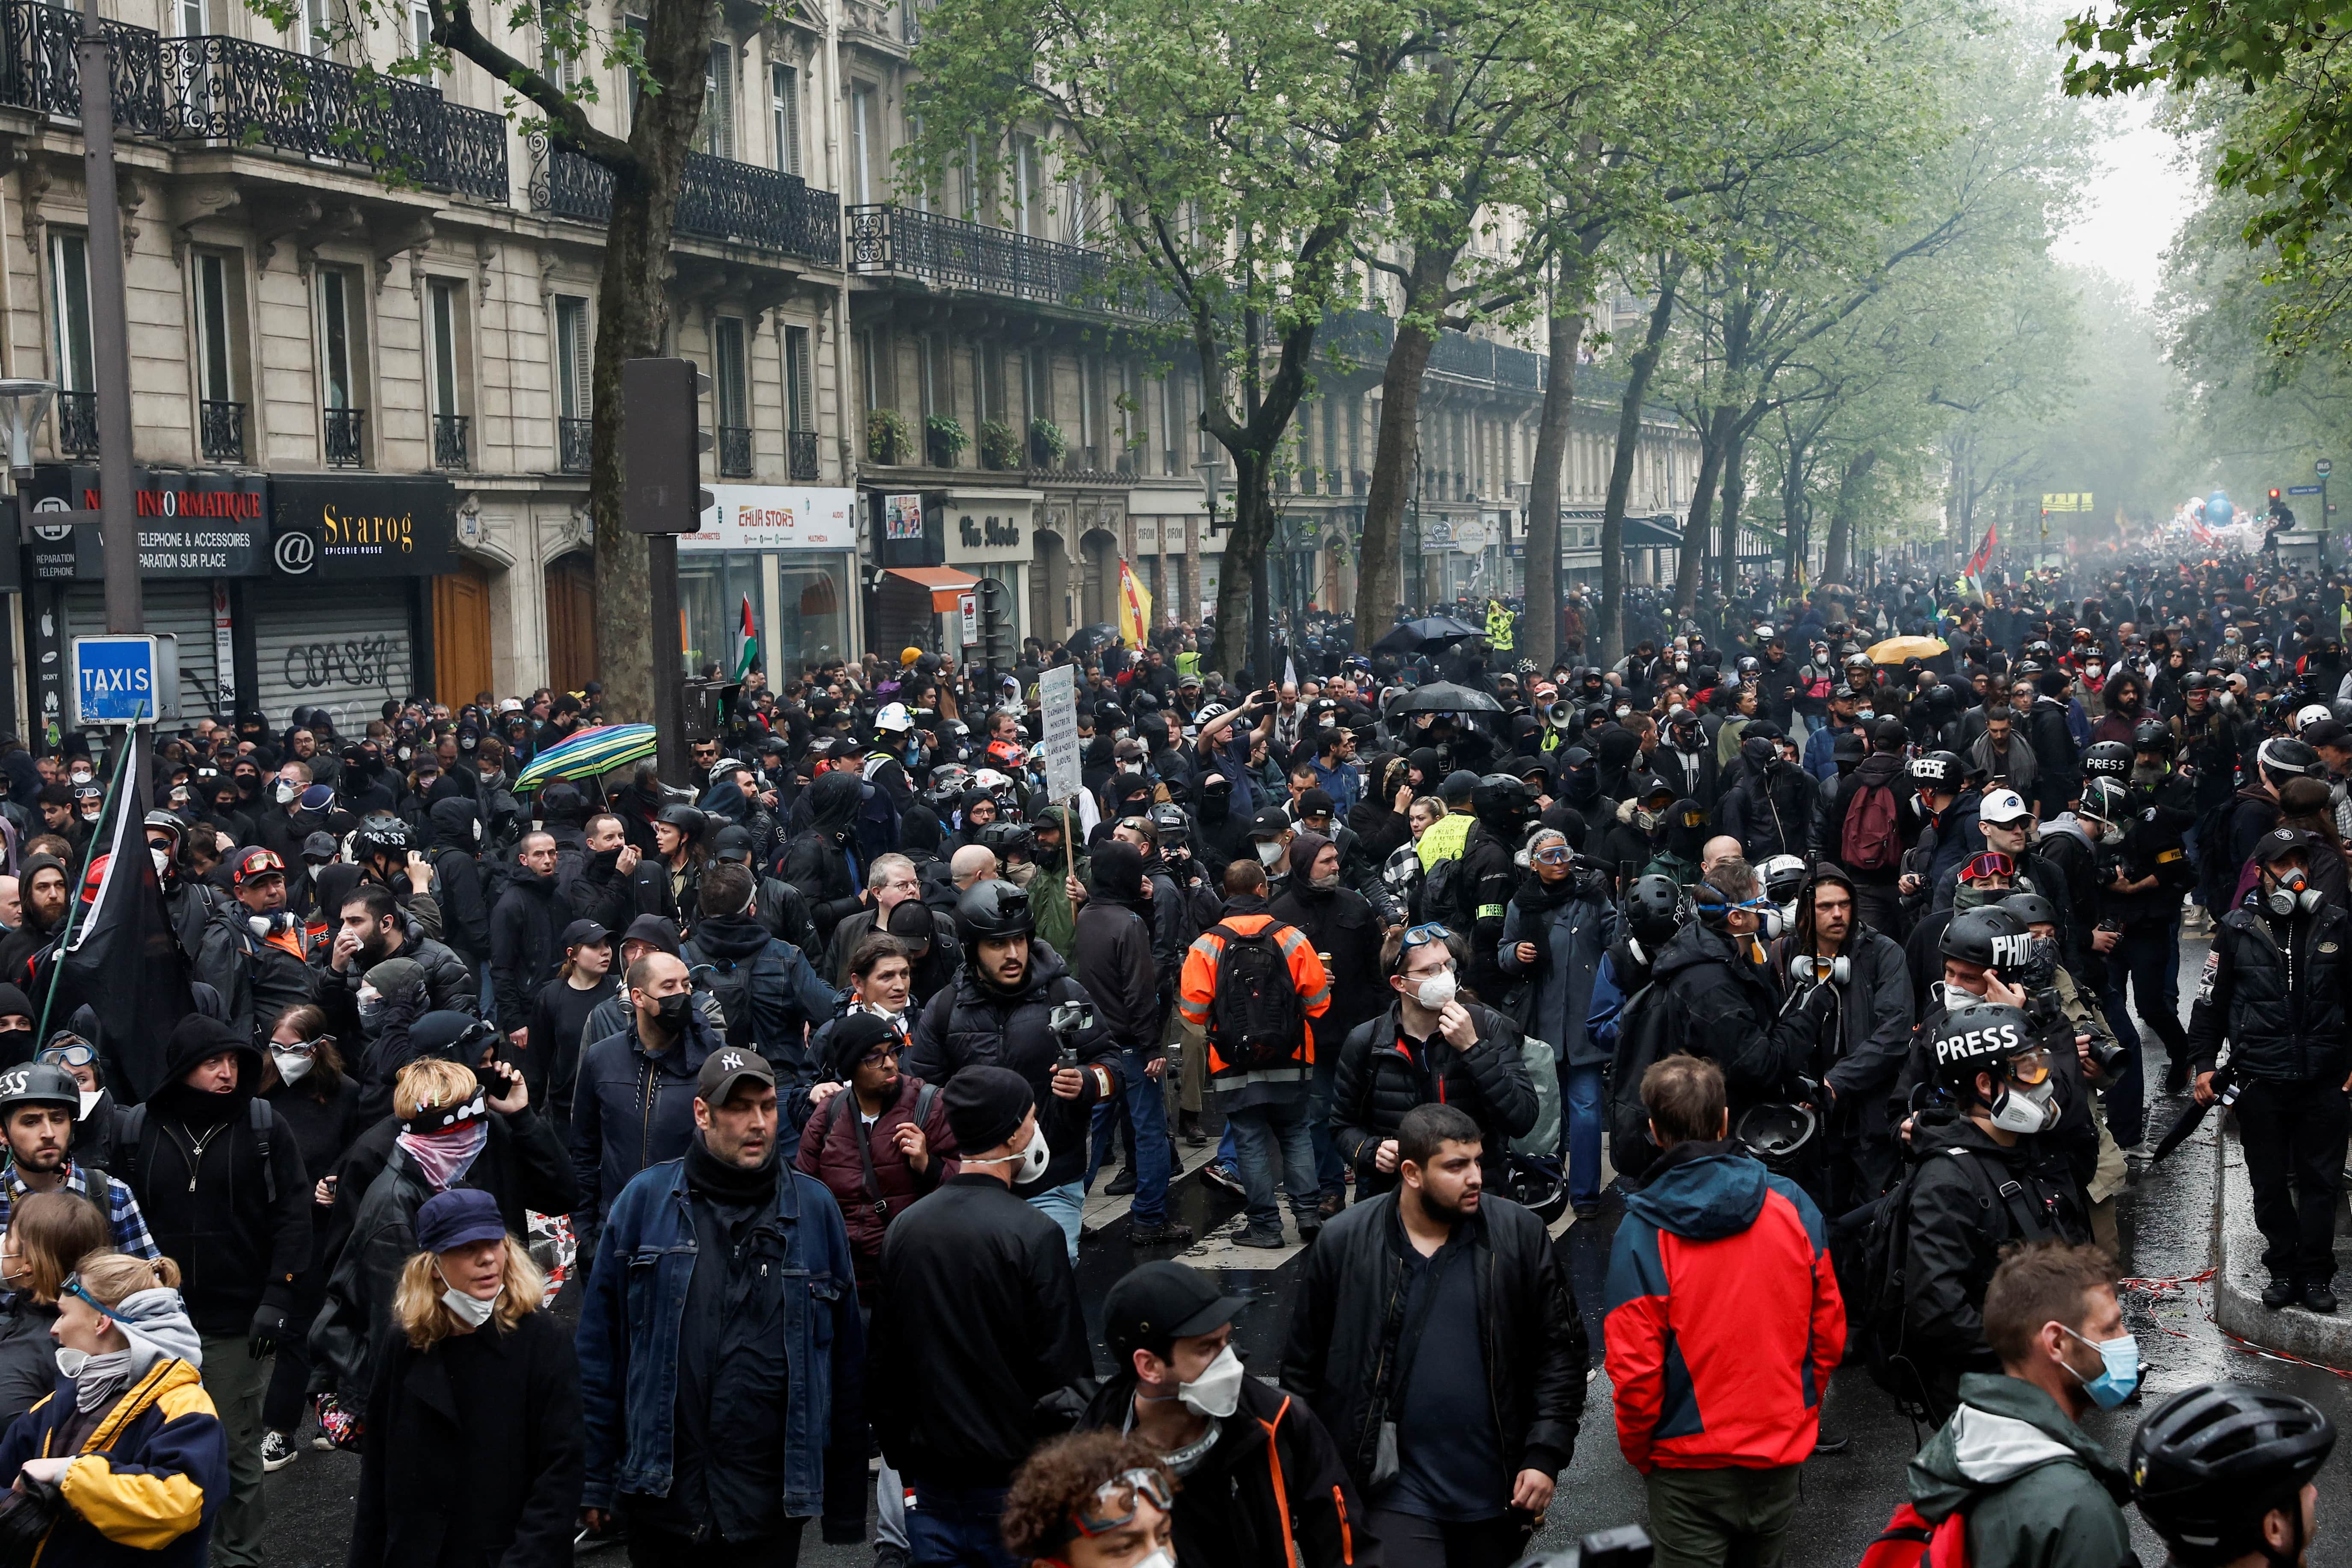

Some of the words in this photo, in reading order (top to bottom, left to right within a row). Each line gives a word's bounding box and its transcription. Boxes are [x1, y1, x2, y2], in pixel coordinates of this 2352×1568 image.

[324, 504, 412, 553] Svarog
[466, 518, 475, 533] 120
[185, 532, 191, 547] &
[194, 533, 250, 547] ACCESSOIRES
[697, 531, 721, 540] CONNECTÉS
[808, 534, 828, 542] MULTIMÉDIA
[325, 546, 357, 555] EPICERIE
[361, 546, 382, 554] RUSSE
[36, 554, 75, 564] RÉPARATION
[139, 553, 177, 568] PARATION
[180, 553, 198, 568] SUR
[201, 553, 226, 567] PLACE
[39, 567, 74, 577] TÉLÉPHONE
[82, 668, 149, 691] TAXIS
[1050, 719, 1066, 729] MINISTRE
[2087, 758, 2124, 770] PRESS
[2105, 784, 2124, 795] PRESS
[364, 832, 406, 846] PRESS
[313, 931, 329, 942] ESS
[1991, 932, 2032, 966] PHOT
[1936, 1025, 2018, 1065] PRESS
[721, 1052, 745, 1071] NY
[0, 1070, 30, 1098] ESS
